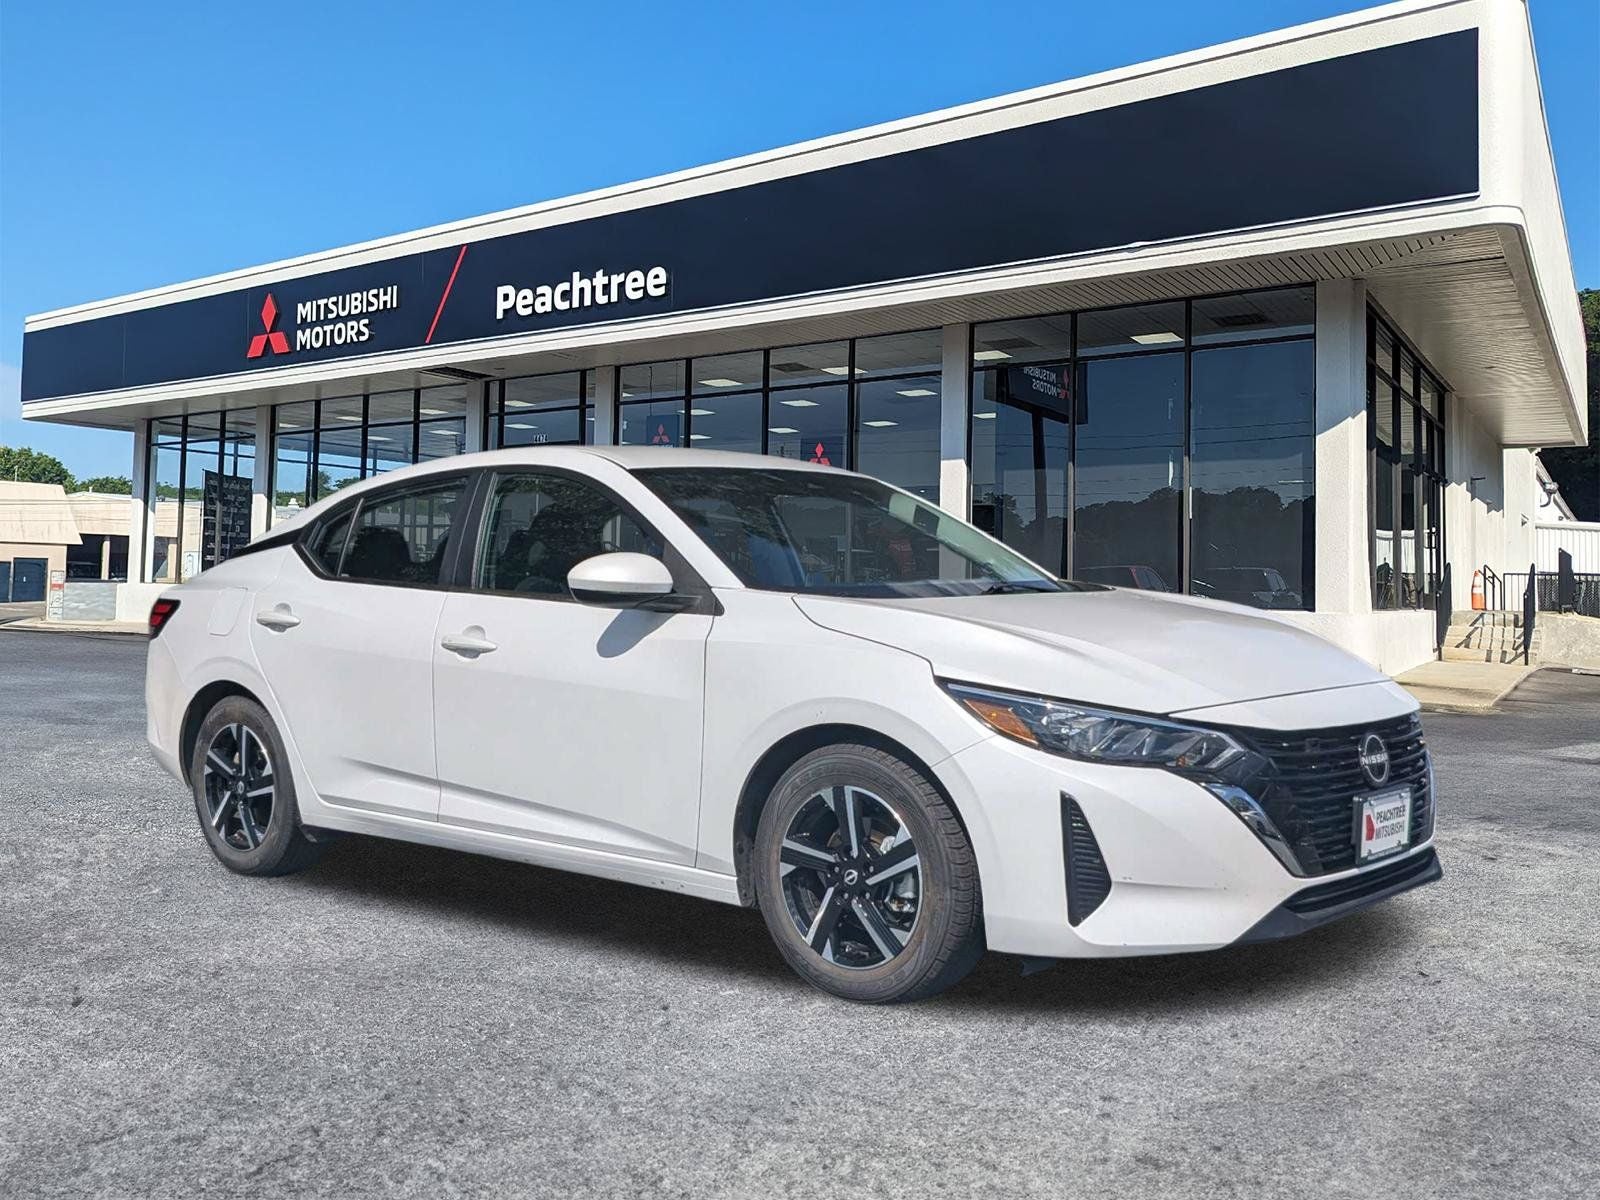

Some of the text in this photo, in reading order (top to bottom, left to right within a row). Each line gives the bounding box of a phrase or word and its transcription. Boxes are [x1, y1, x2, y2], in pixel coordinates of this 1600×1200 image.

[297, 285, 398, 324] MITSUBISHI
[496, 266, 667, 320] Peachtree
[296, 319, 370, 351] MOTORS
[1375, 821, 1404, 839] MITSUBISHI
[1376, 804, 1406, 824] PEACHTREE
